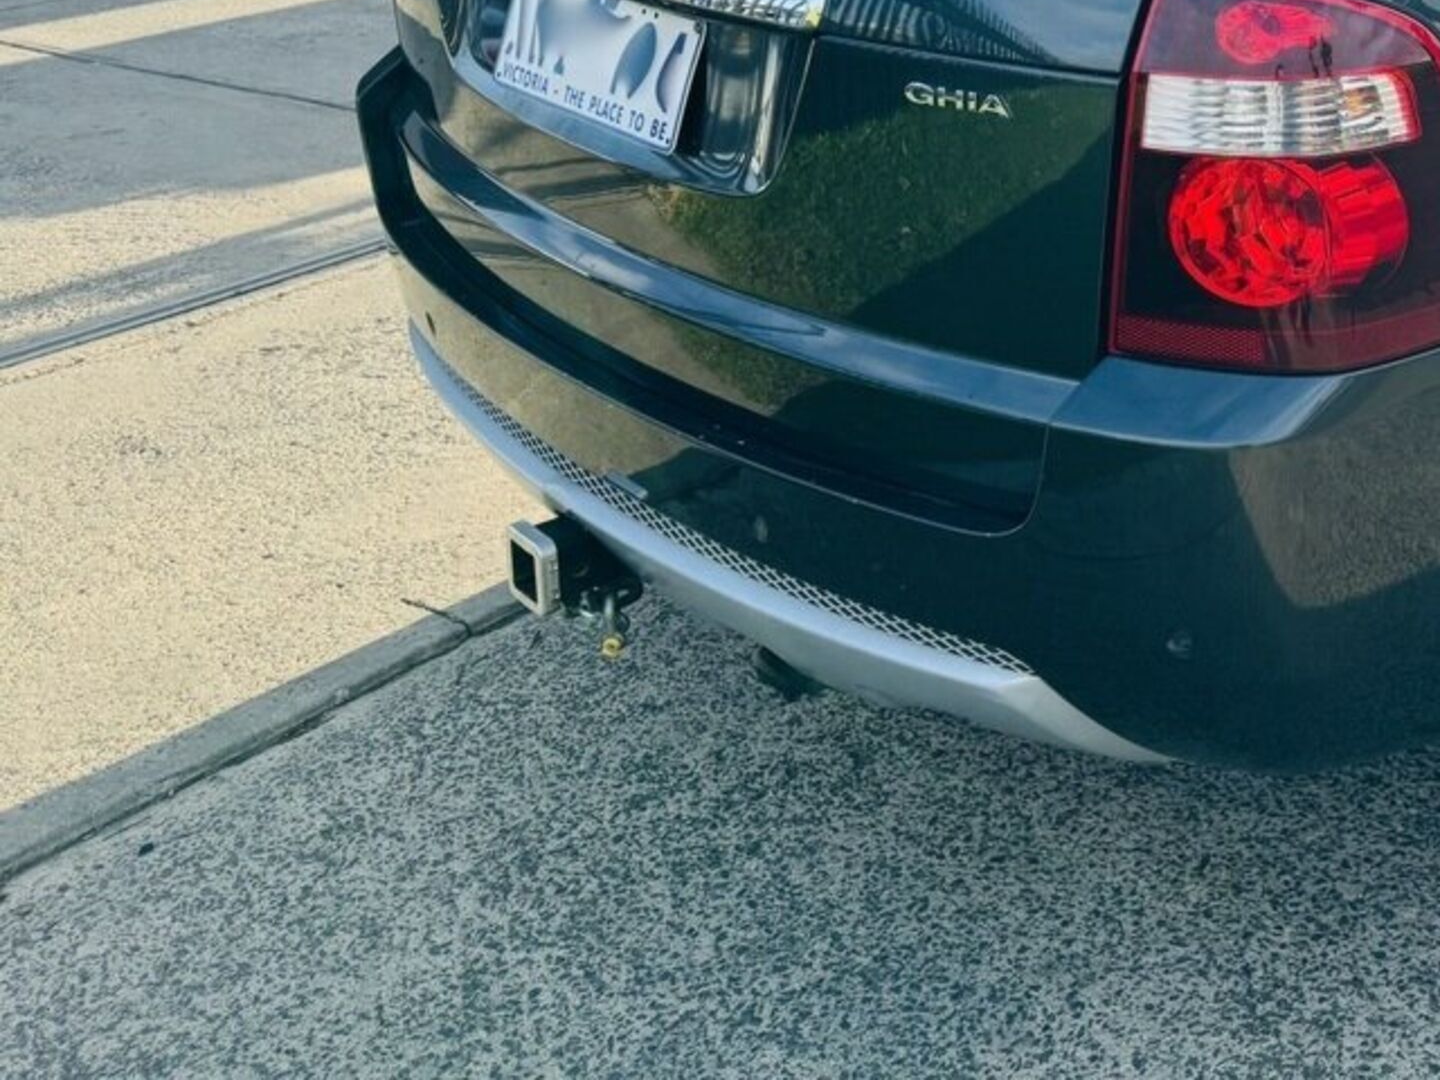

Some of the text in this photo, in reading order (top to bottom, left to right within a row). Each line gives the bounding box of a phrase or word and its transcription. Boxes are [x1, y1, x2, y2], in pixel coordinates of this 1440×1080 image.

[502, 64, 548, 95] VICTORIA
[563, 85, 585, 108] THE
[588, 95, 623, 124] PLACE
[628, 110, 645, 132] TO
[904, 81, 1010, 119] GHIA
